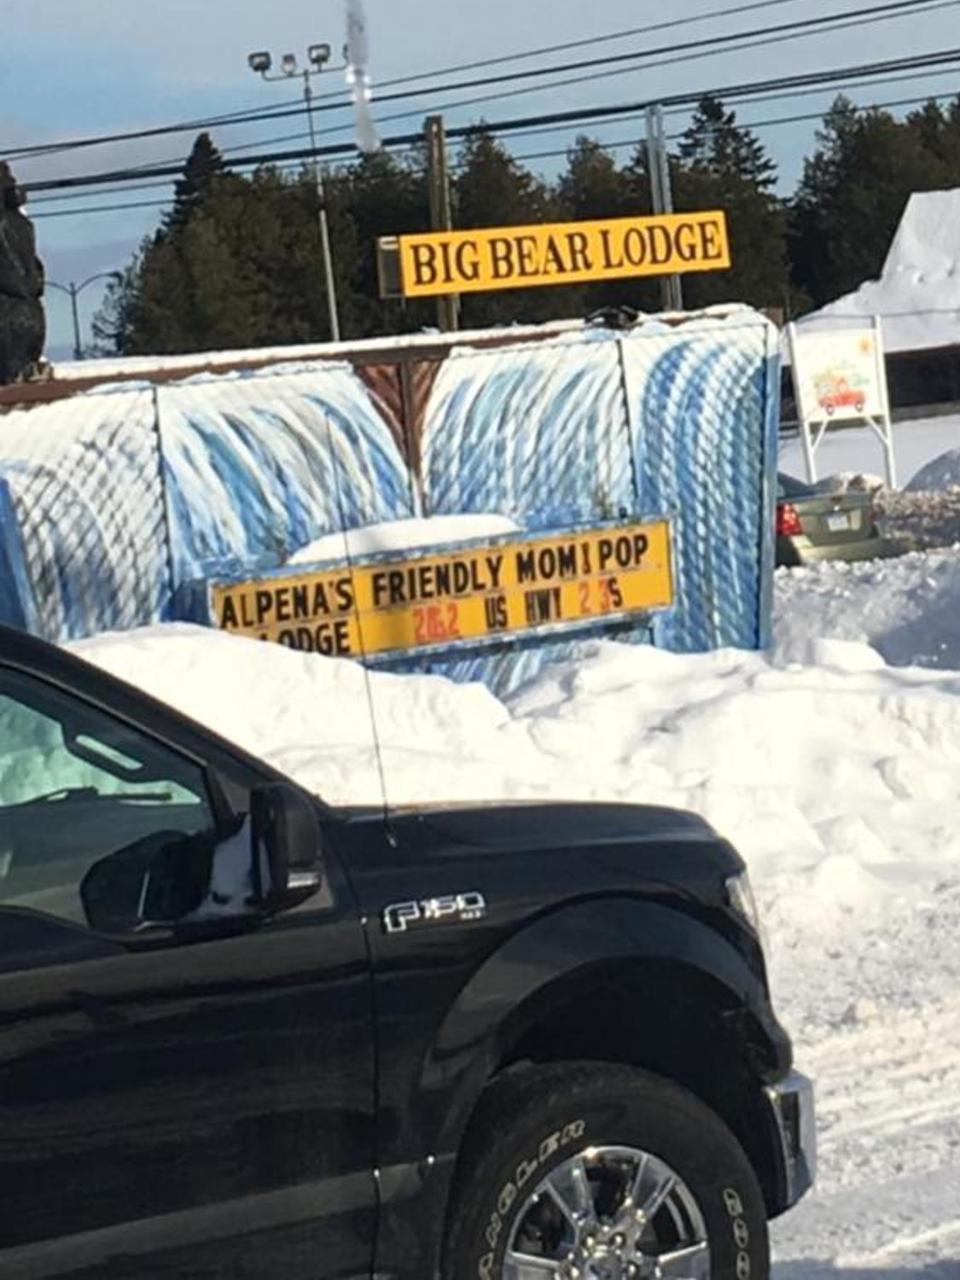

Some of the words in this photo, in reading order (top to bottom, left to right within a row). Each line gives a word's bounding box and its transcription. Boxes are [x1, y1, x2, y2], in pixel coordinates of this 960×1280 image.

[409, 240, 481, 287] BIG
[489, 231, 593, 280] BEAR
[600, 219, 724, 270] LODGE
[220, 577, 354, 629] ALPENA'S
[372, 554, 504, 607] FRIENDLY
[516, 543, 578, 584] MOM
[598, 532, 649, 572] POP
[260, 619, 351, 657] ODGE
[484, 595, 508, 630] US
